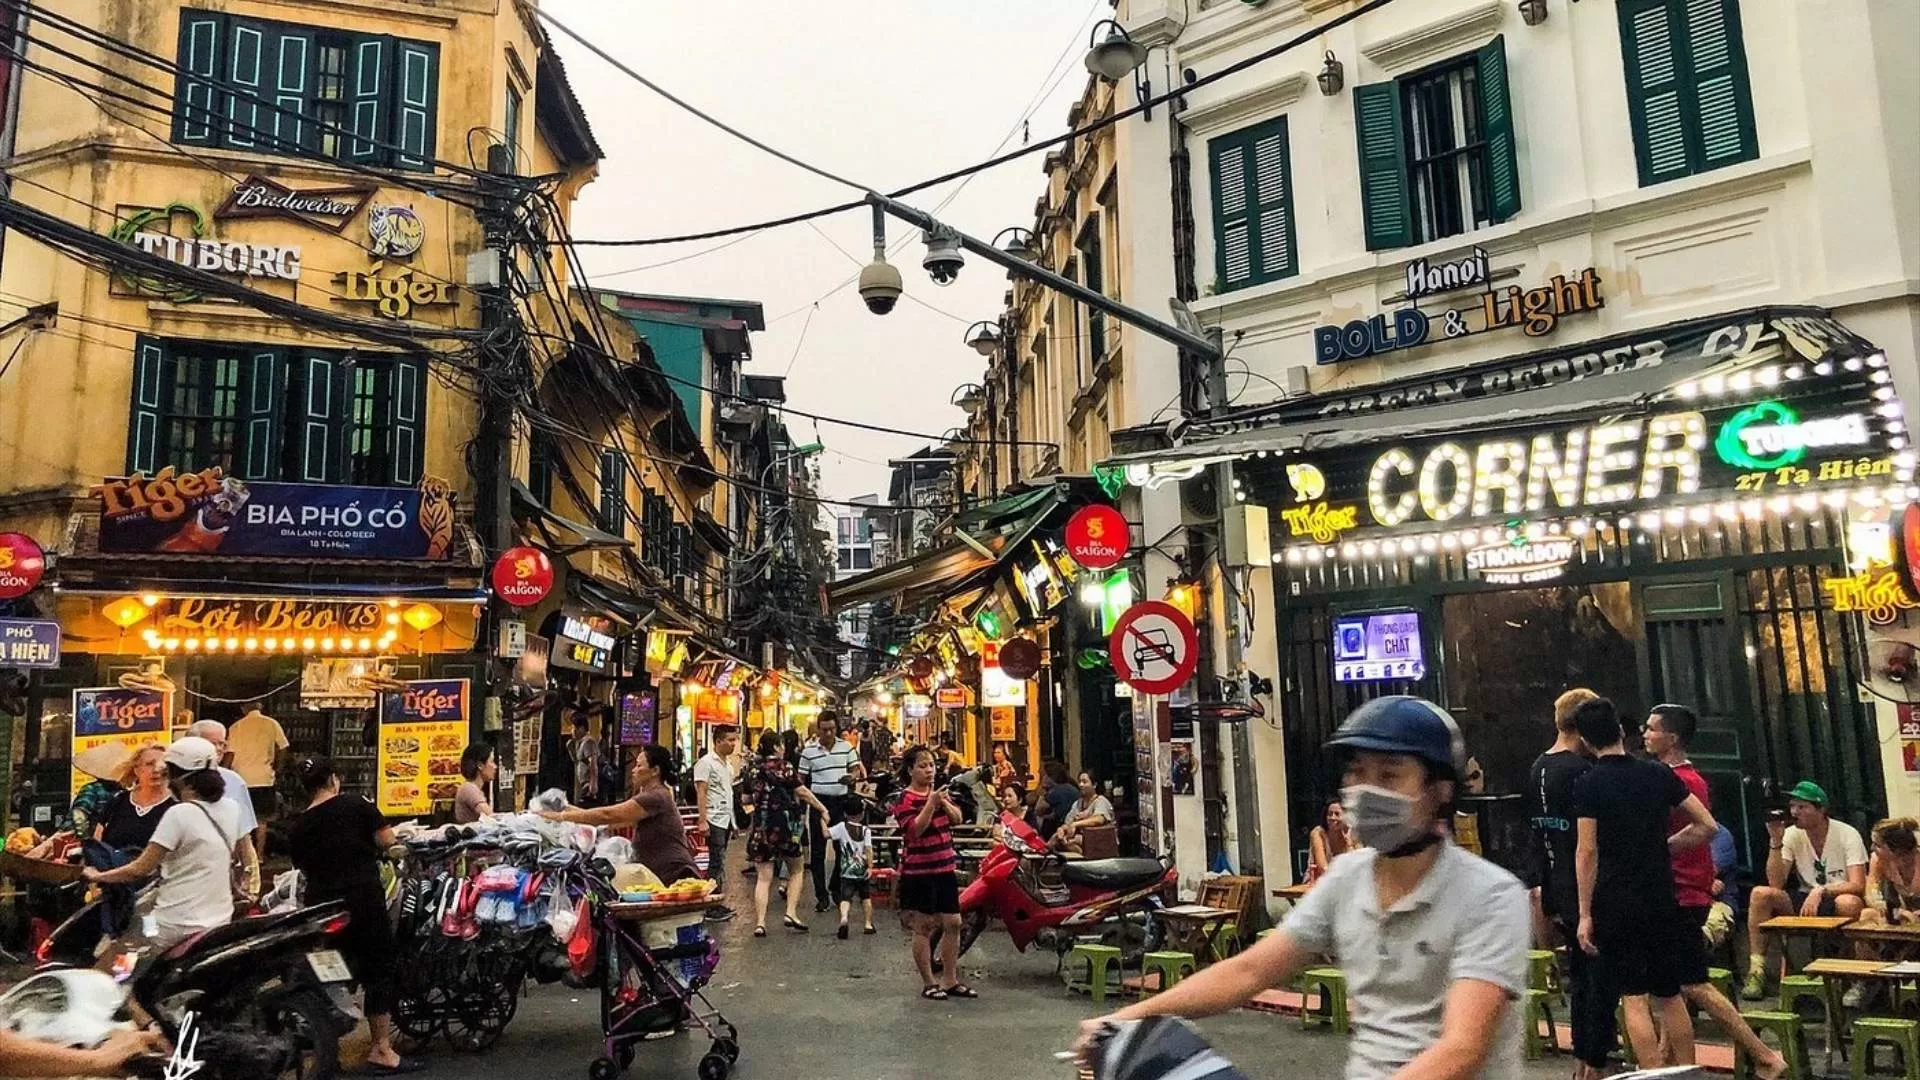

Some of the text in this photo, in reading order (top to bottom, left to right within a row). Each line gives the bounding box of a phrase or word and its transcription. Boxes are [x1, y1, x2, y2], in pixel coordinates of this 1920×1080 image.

[233, 184, 358, 216] Budweiser
[134, 231, 301, 281] TUBORG
[1407, 246, 1489, 297] Hanoi
[336, 260, 453, 319] Tiger
[1314, 267, 1605, 365] BOLD & Light
[1368, 411, 1707, 526] CORNER
[1734, 471, 1767, 491] 27
[91, 465, 222, 520] Tiger
[247, 504, 293, 526] BIA
[302, 499, 359, 527] PHỐ
[1281, 501, 1357, 544] Tiger
[327, 530, 351, 538] COLD
[1075, 545, 1116, 556] SAIGON
[1466, 541, 1573, 569] STRONGBOW
[504, 586, 542, 595] SAIGON
[1486, 573, 1520, 584] APPLE
[256, 600, 336, 631] Béo
[348, 602, 379, 625] 18
[6, 625, 33, 637] PHỐ
[11, 640, 49, 662] HIỆN
[96, 697, 160, 729] Tiger
[402, 688, 458, 718] Tiger
